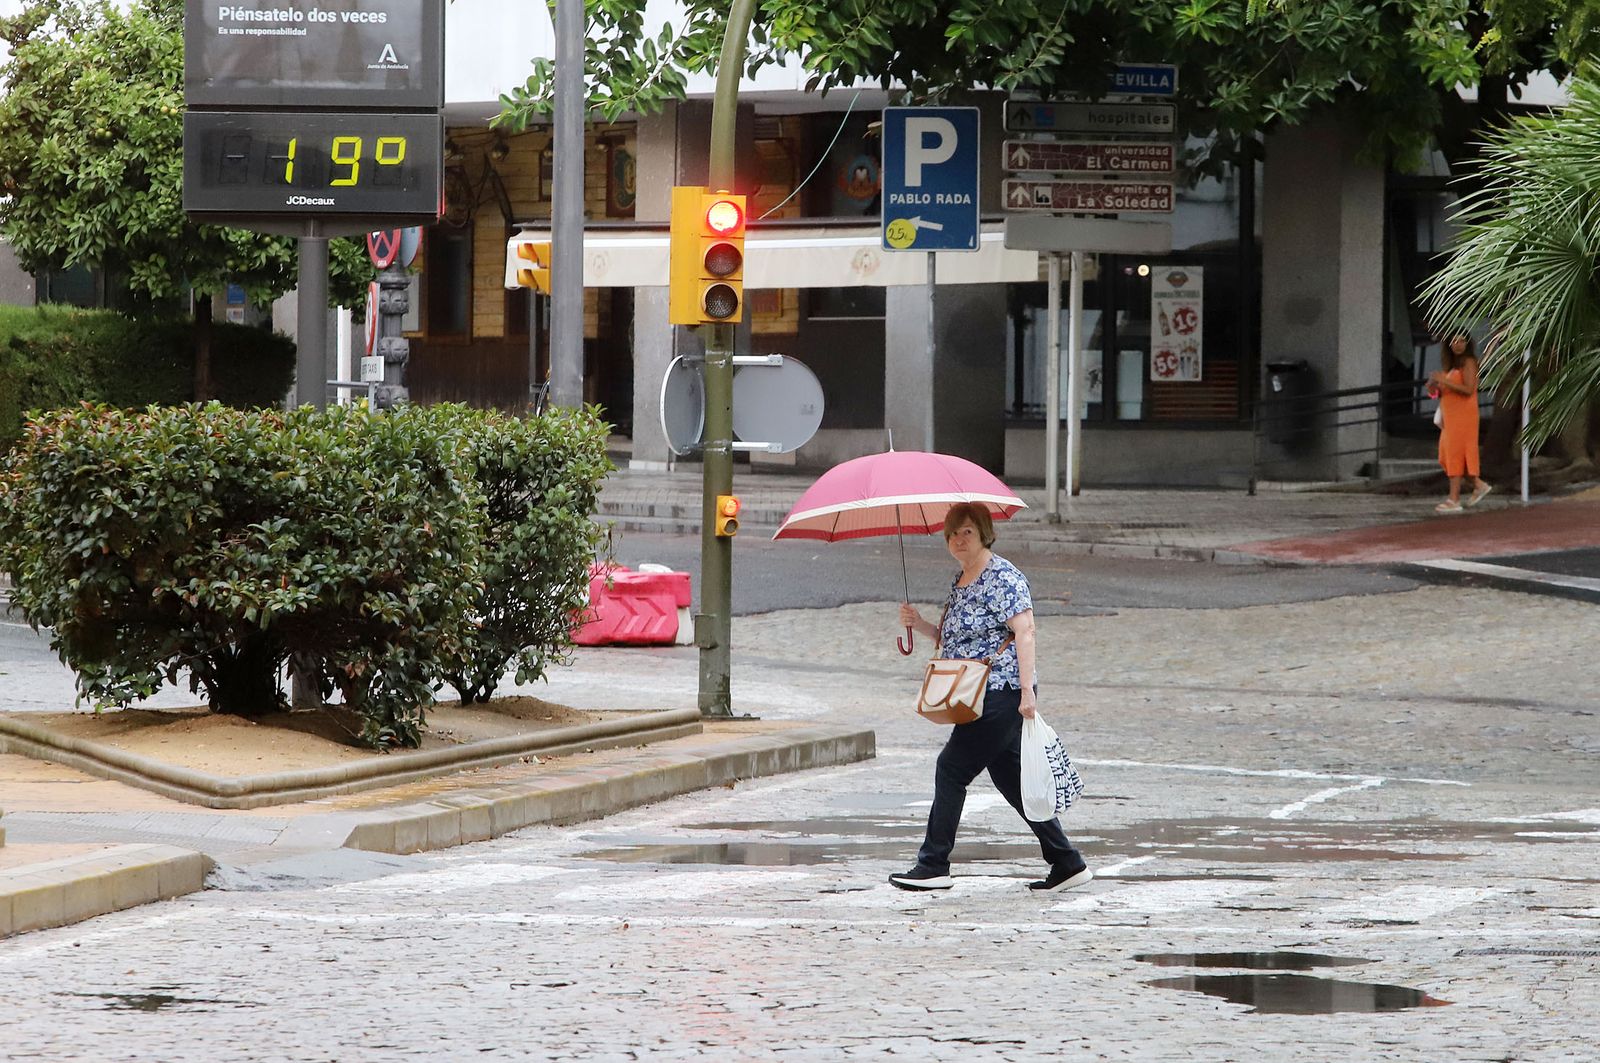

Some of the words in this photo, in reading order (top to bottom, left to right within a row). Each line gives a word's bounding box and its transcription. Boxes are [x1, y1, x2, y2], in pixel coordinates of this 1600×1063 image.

[218, 6, 304, 22] Piénsatelo
[307, 8, 337, 23] dos
[340, 11, 387, 23] veces
[218, 27, 228, 35] Es
[245, 27, 307, 37] responsabilidad
[1088, 111, 1170, 126] hospitales
[905, 117, 958, 187] P
[1105, 147, 1169, 156] universidad
[1086, 156, 1102, 169] El
[1109, 156, 1169, 170] Carmen
[1113, 185, 1150, 194] ermita
[1154, 186, 1169, 194] de
[286, 196, 335, 206] JCDecaux
[889, 193, 931, 205] PABLO
[936, 193, 972, 205] RADA
[1077, 195, 1096, 208] La
[1104, 195, 1169, 209] Soledad
